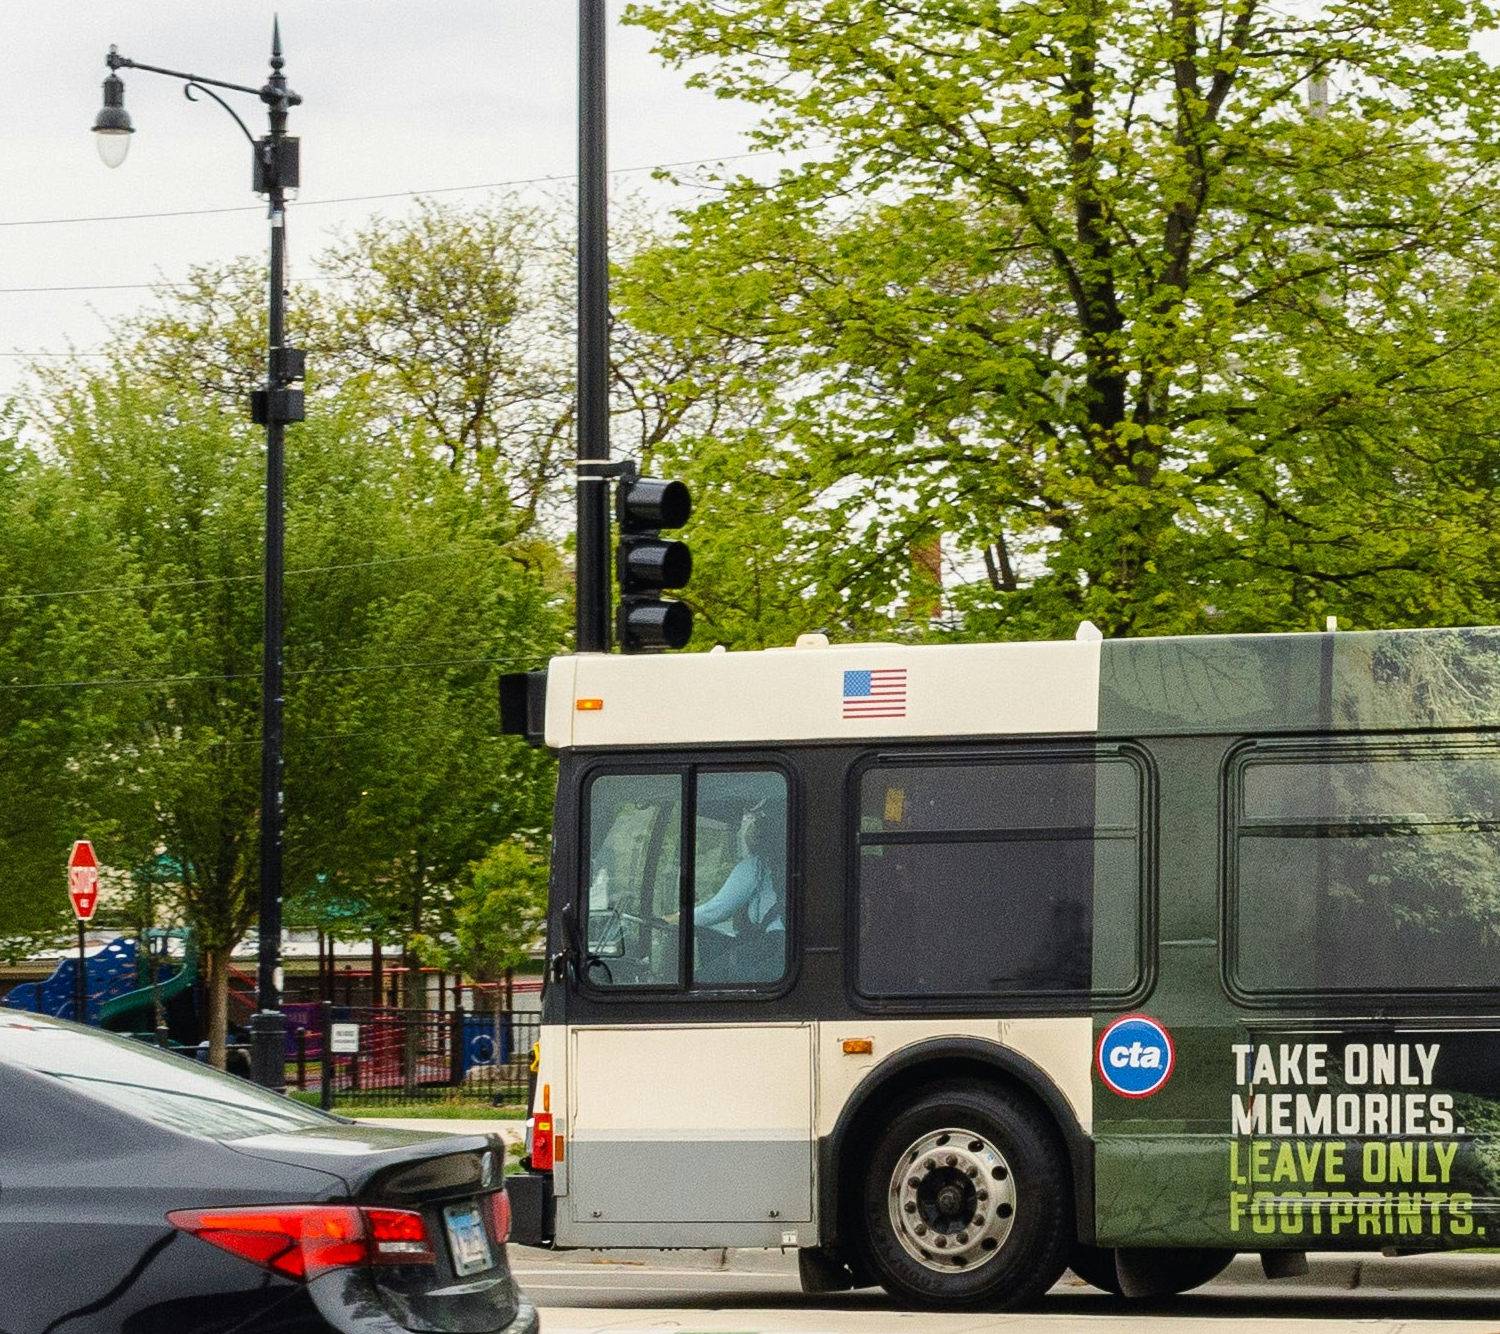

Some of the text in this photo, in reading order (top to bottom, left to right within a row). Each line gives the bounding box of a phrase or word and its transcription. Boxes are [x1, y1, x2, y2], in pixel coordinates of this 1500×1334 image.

[1109, 1041, 1161, 1069] cta
[1231, 1043, 1441, 1086] TAKE ONLY
[1231, 1093, 1466, 1135] MEMORIES.
[1230, 1140, 1459, 1186] LEAVE ONLY
[1229, 1189, 1486, 1236] FOOTPRINTS.
